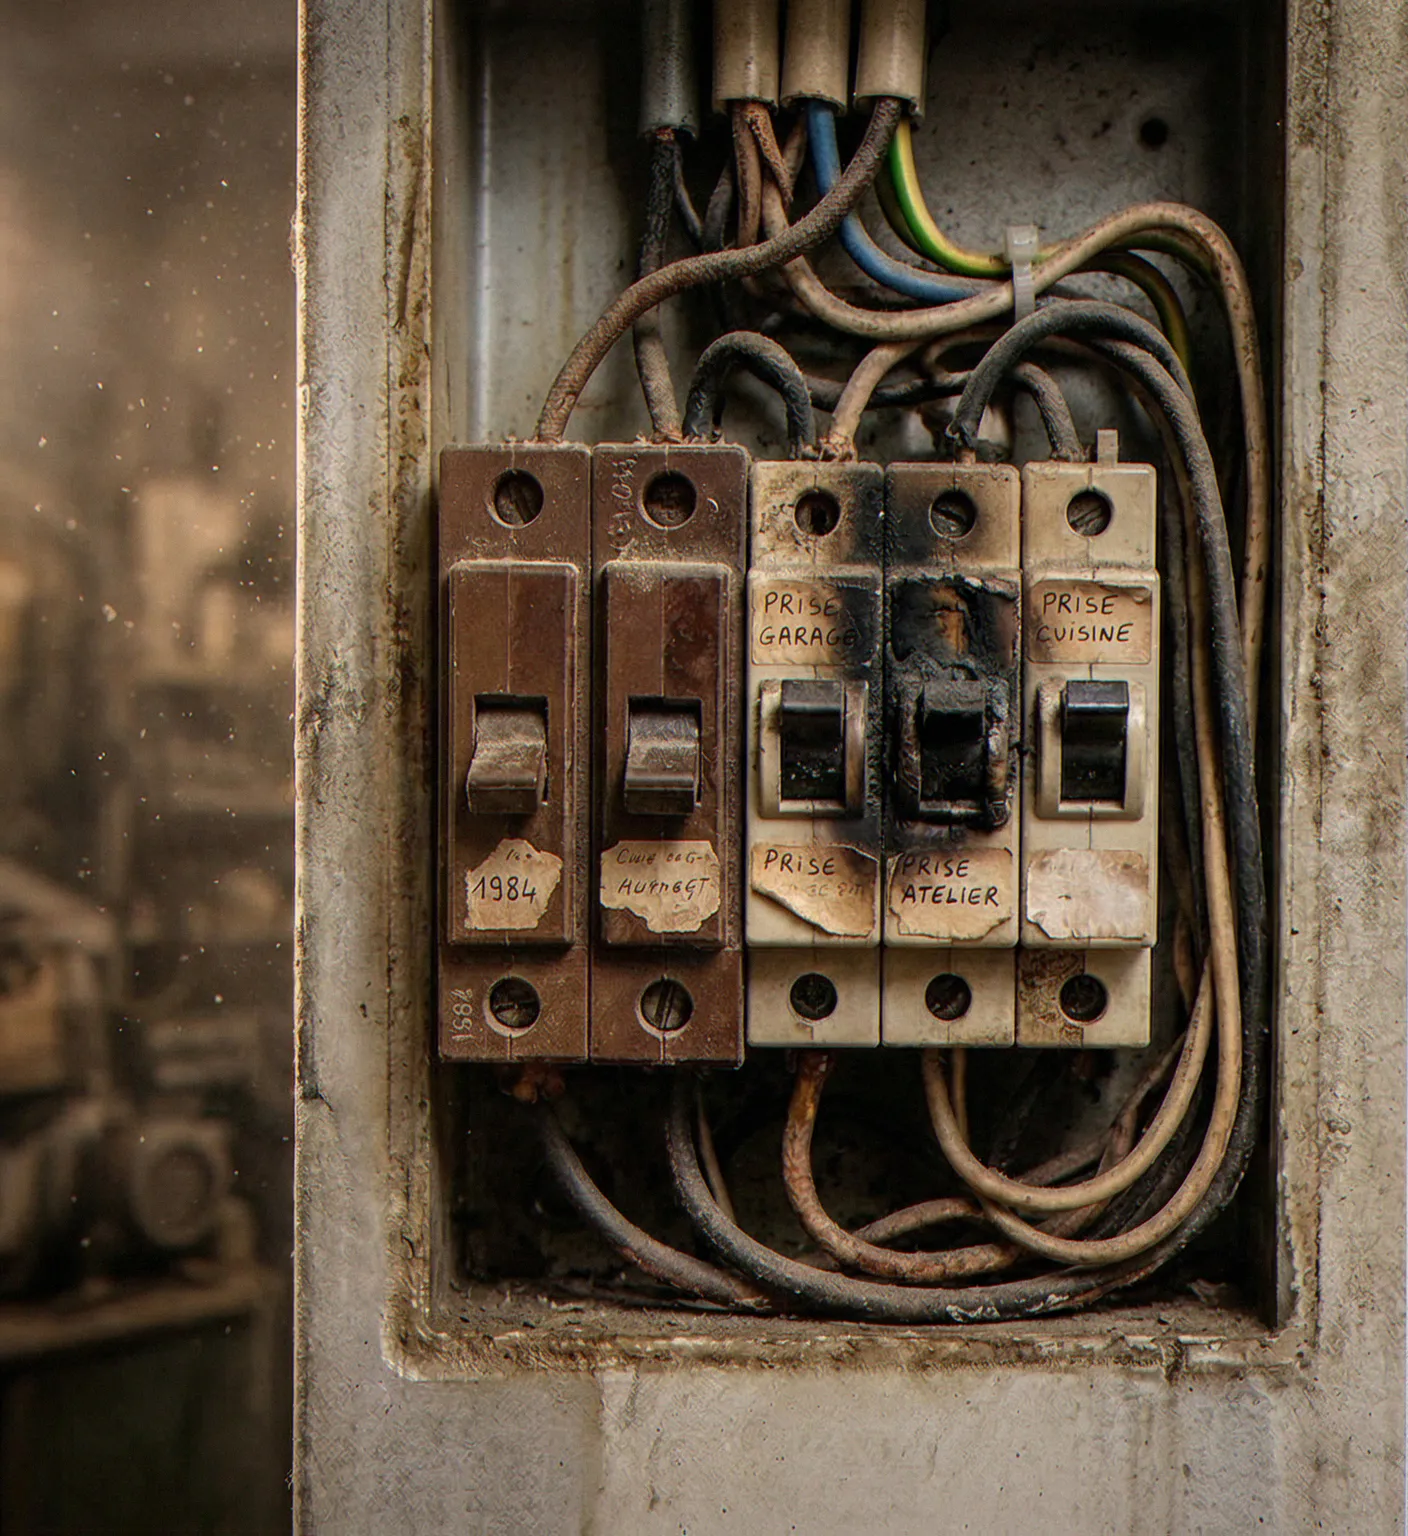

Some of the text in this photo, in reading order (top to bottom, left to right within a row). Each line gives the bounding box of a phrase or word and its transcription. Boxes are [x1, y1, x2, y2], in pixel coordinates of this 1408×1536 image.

[1042, 591, 1119, 616] PRISE
[900, 856, 970, 878] PRISE
[471, 875, 537, 904] 1984
[901, 884, 1000, 908] ATELIER
